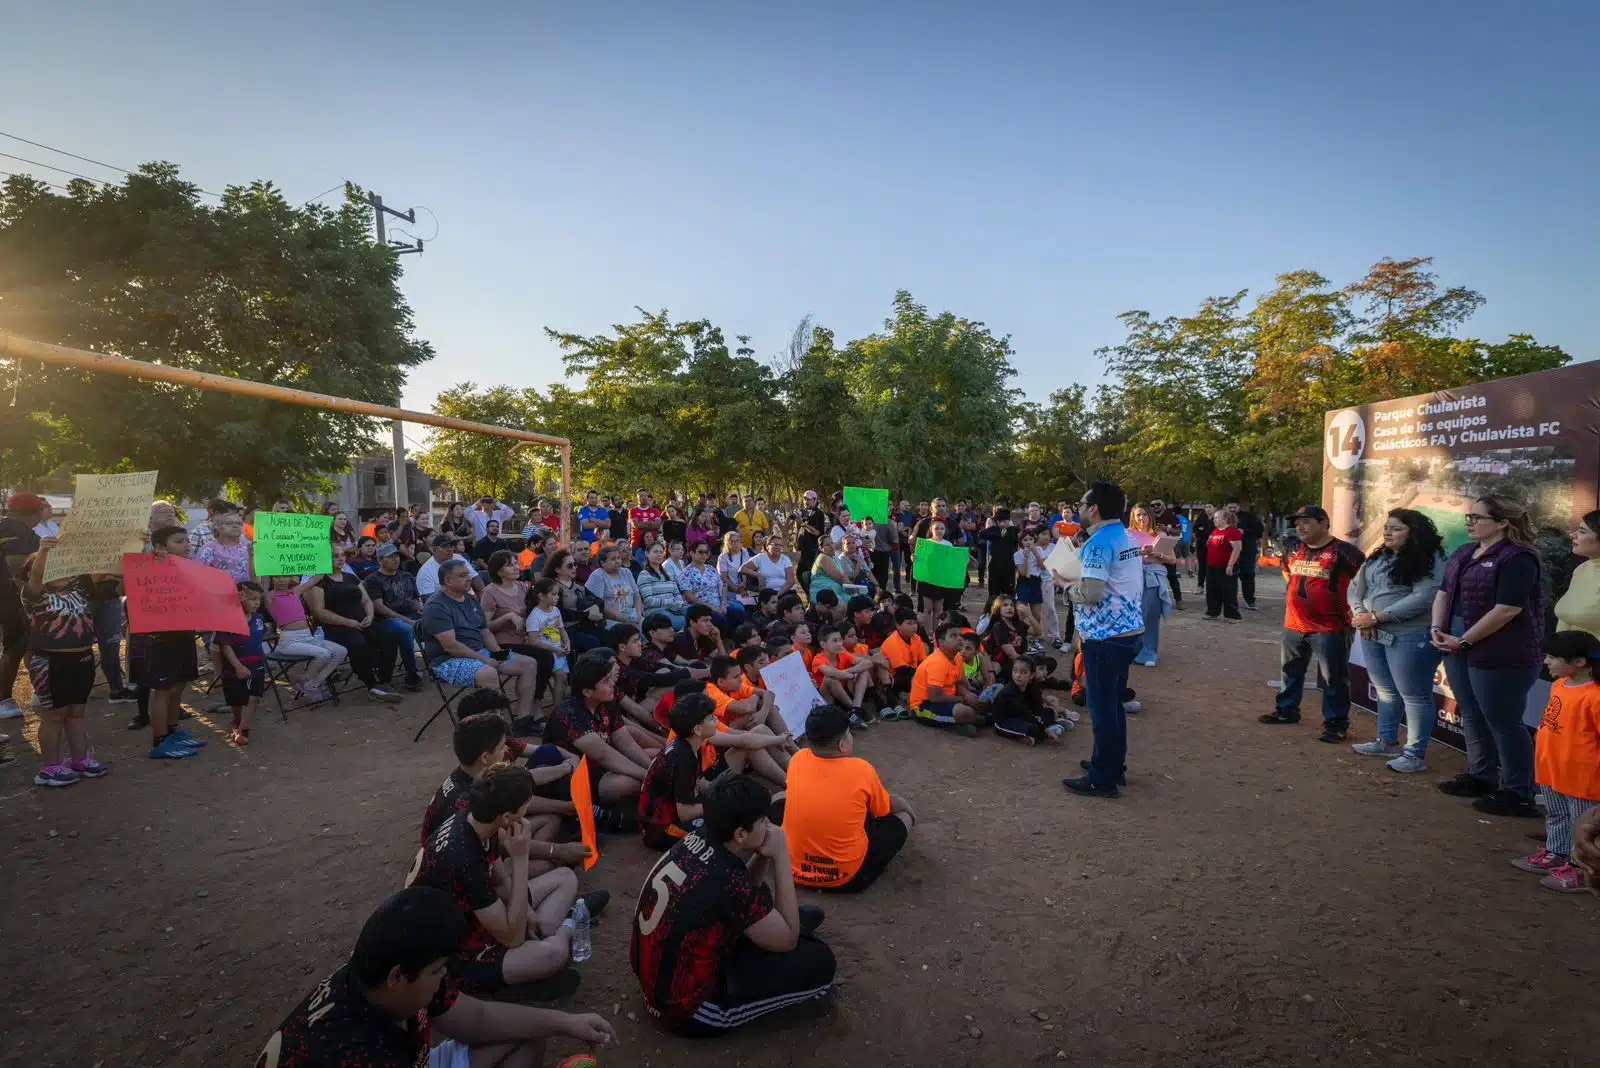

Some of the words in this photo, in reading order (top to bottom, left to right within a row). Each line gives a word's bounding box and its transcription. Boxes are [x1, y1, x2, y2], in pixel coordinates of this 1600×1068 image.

[1373, 407, 1414, 423] Parque
[1417, 395, 1486, 417] Chulavista
[1373, 425, 1399, 438] Casa
[1400, 423, 1413, 435] de
[1416, 421, 1433, 433] los
[1436, 414, 1487, 433] equipos
[1430, 436, 1447, 447] FA
[1449, 435, 1456, 448] y
[1460, 425, 1535, 444] Chulavista
[1539, 421, 1560, 437] FC
[1329, 423, 1362, 458] 14
[293, 518, 302, 527] DE
[281, 563, 295, 574] POR
[297, 562, 317, 573] FAVOR
